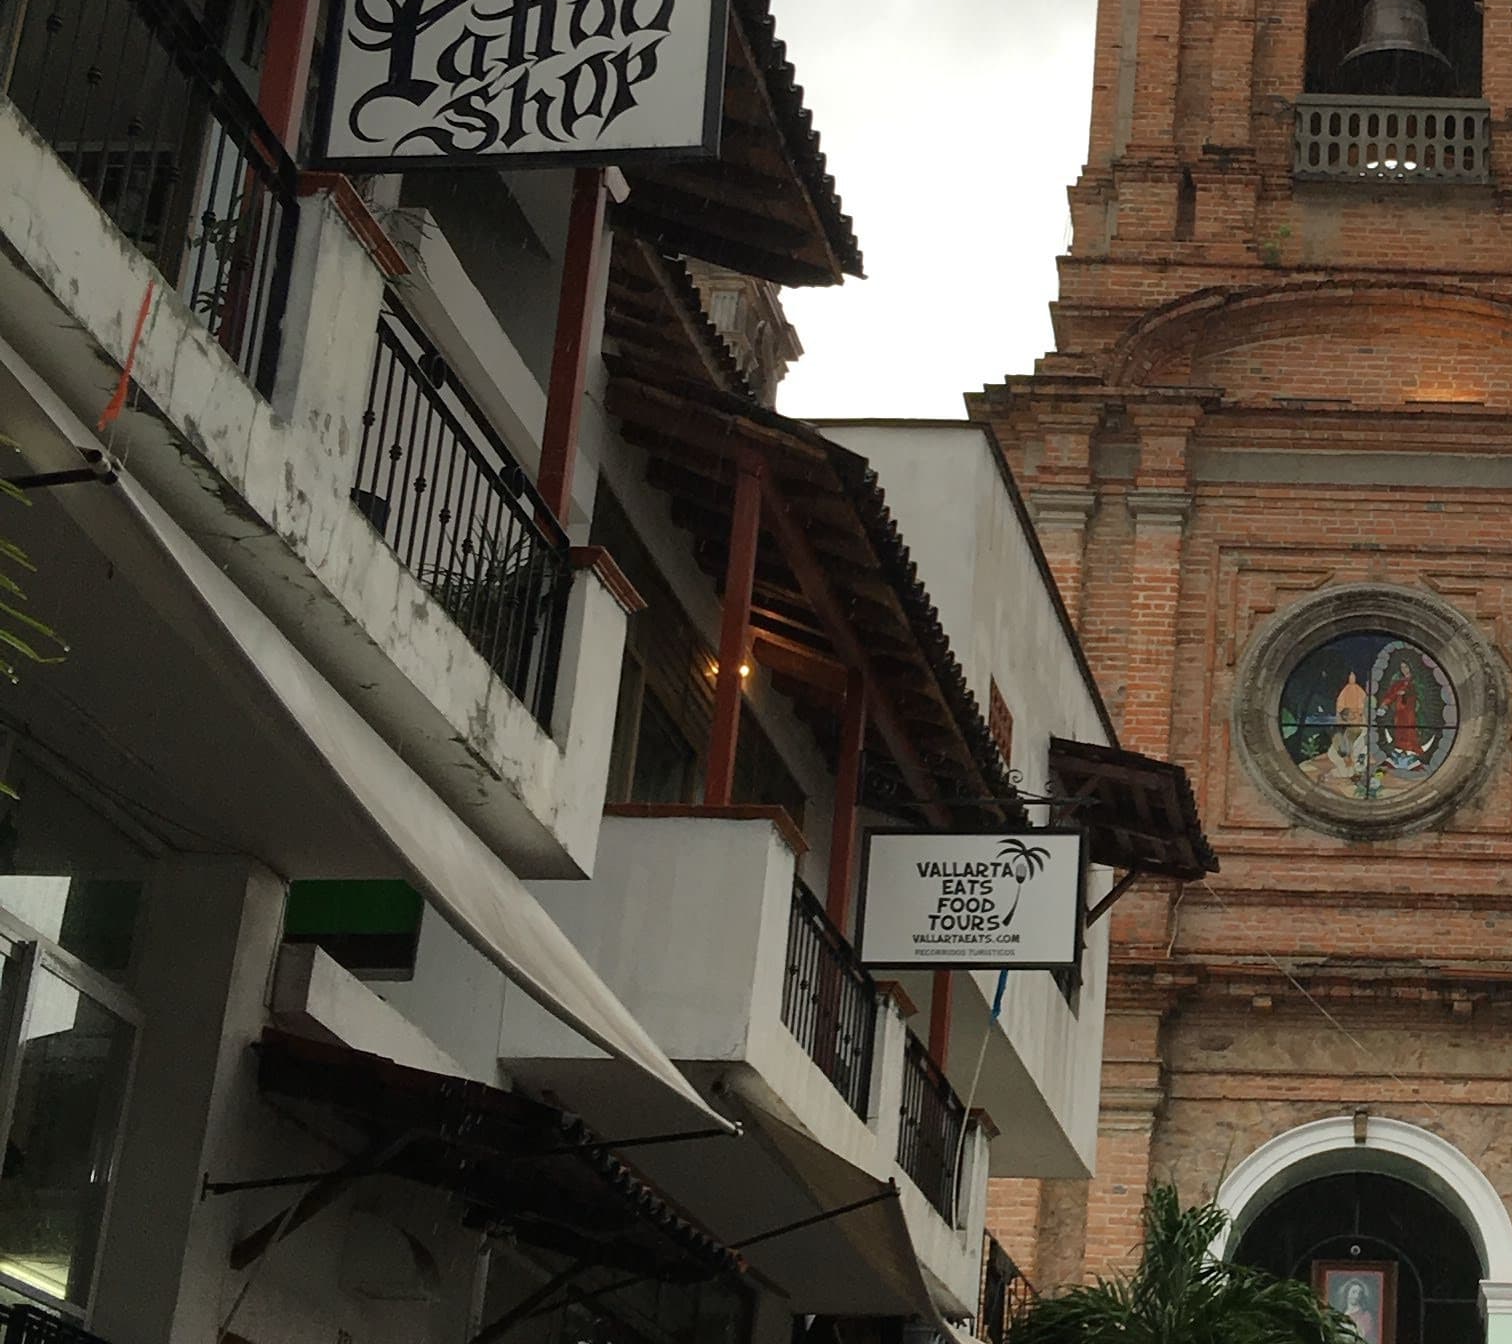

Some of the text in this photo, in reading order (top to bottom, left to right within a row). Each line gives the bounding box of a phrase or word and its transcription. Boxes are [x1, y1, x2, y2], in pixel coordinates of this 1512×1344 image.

[916, 861, 1014, 878] VALLARTA
[942, 879, 994, 896] EATS
[937, 897, 996, 913] FOOD
[928, 914, 1001, 931] TOURS
[912, 934, 1020, 944] VALLARTAEATS.COM
